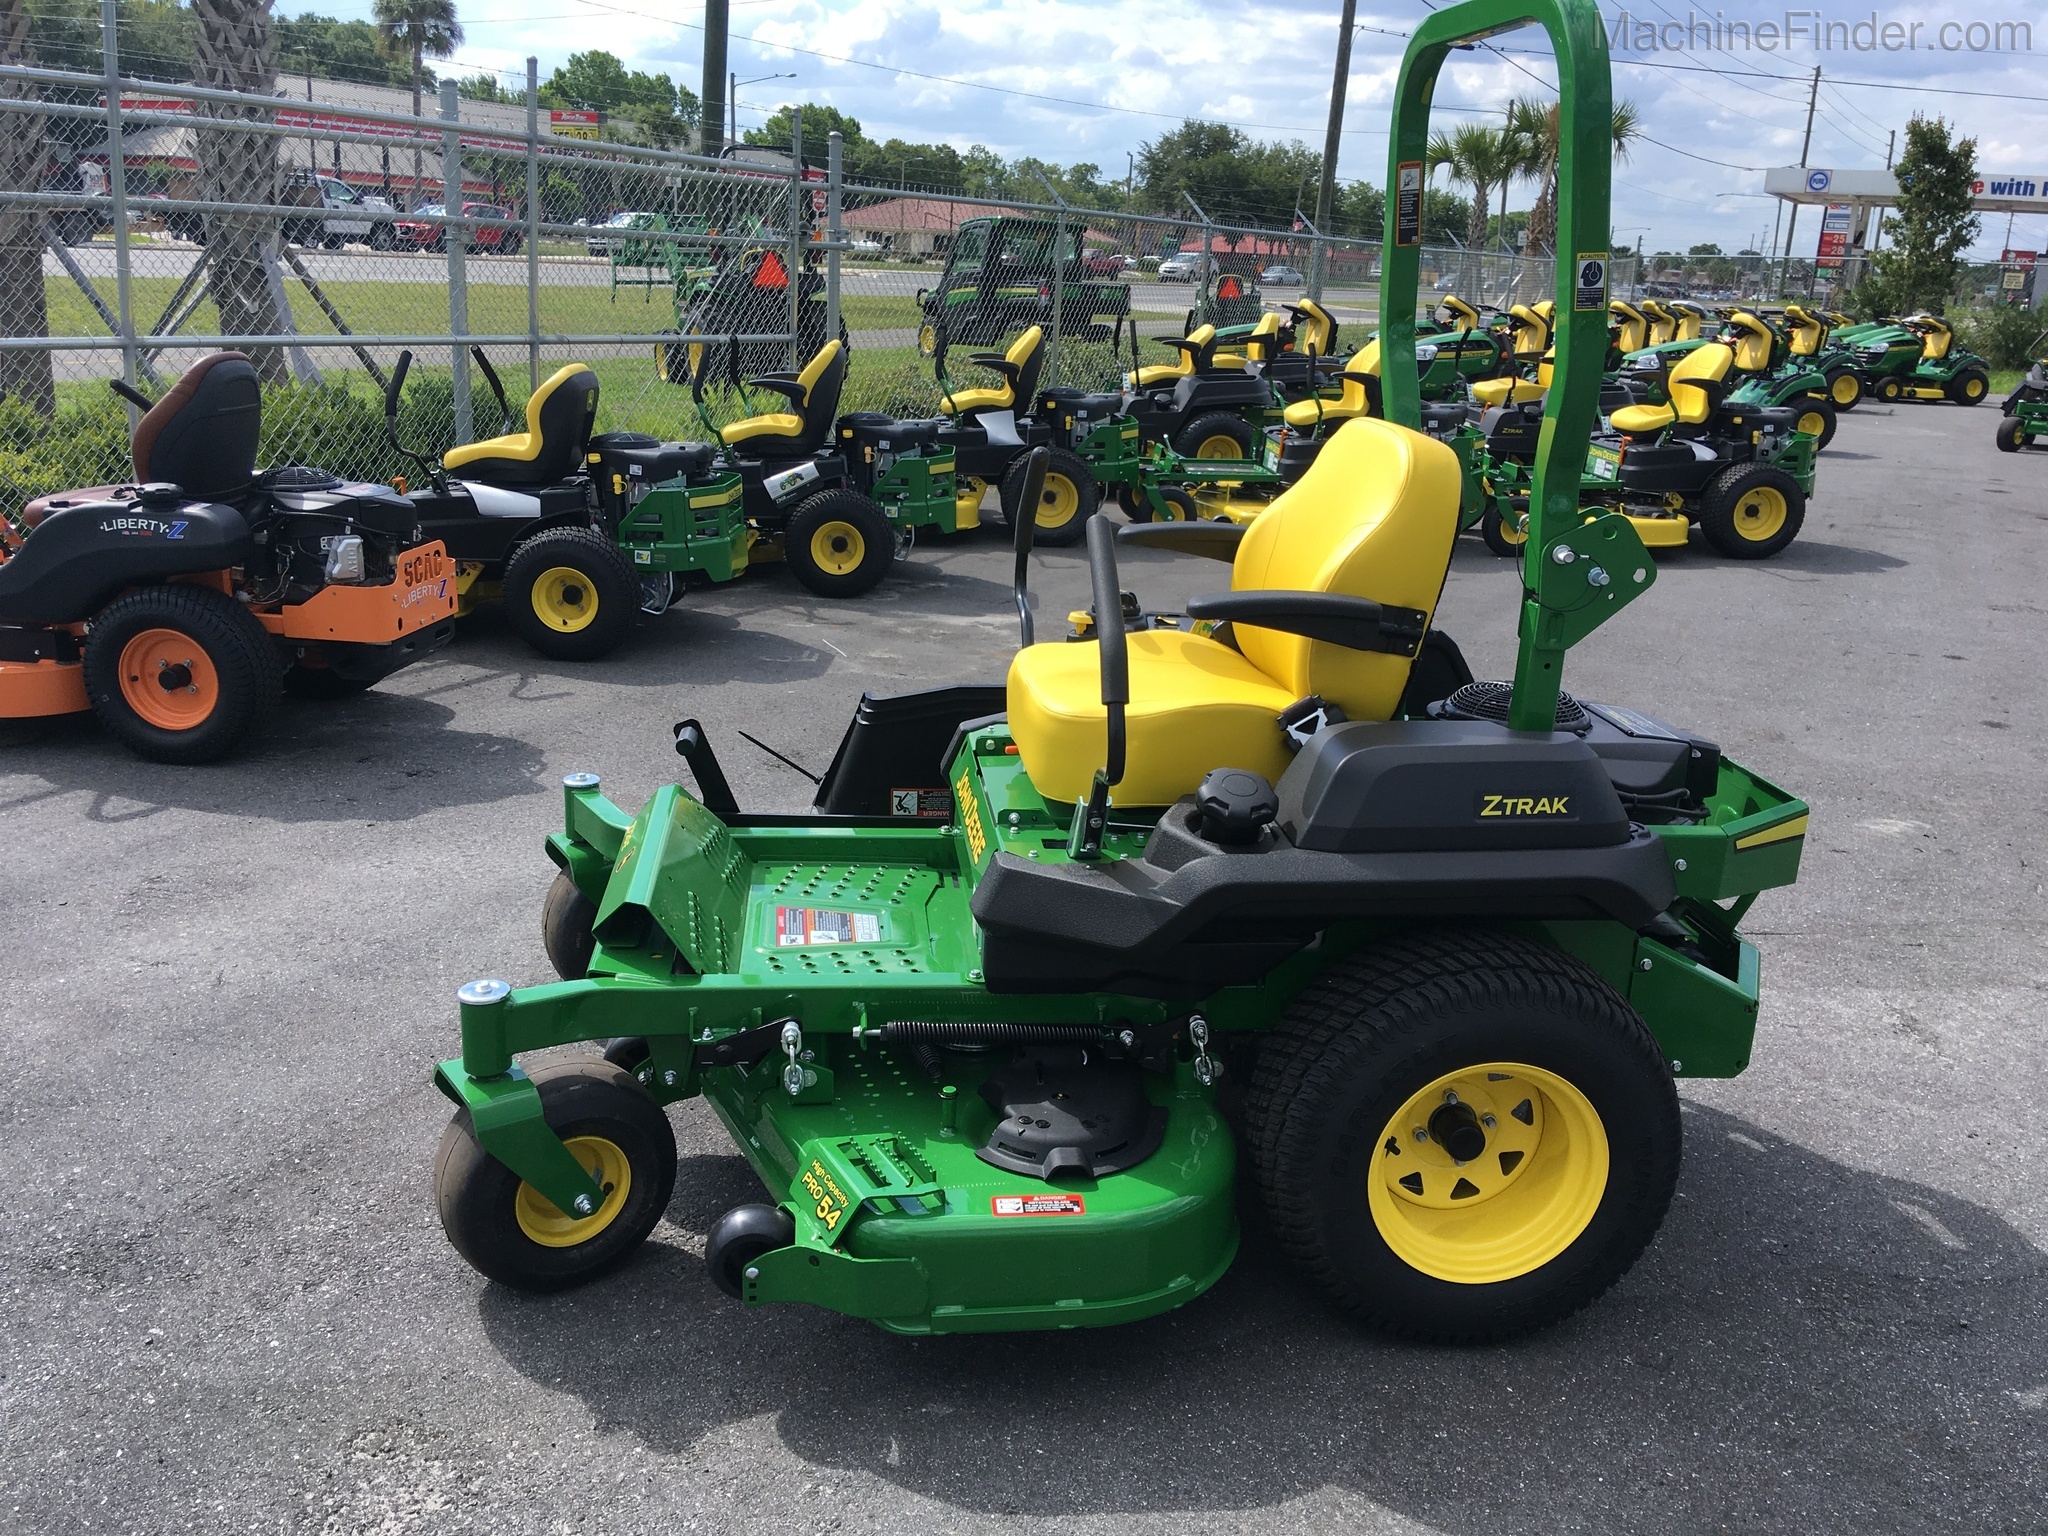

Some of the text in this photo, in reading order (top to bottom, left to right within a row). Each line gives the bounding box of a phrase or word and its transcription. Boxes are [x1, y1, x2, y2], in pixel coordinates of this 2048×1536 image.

[1991, 177, 2036, 197] with
[103, 518, 189, 539] LIBERTY Z
[402, 578, 448, 609] LIBERTY Z
[956, 766, 987, 866] JOHN DEERE
[1480, 795, 1570, 816] ZTRAK
[812, 1159, 850, 1208] High Capacity
[801, 1171, 841, 1230] PRO 54
